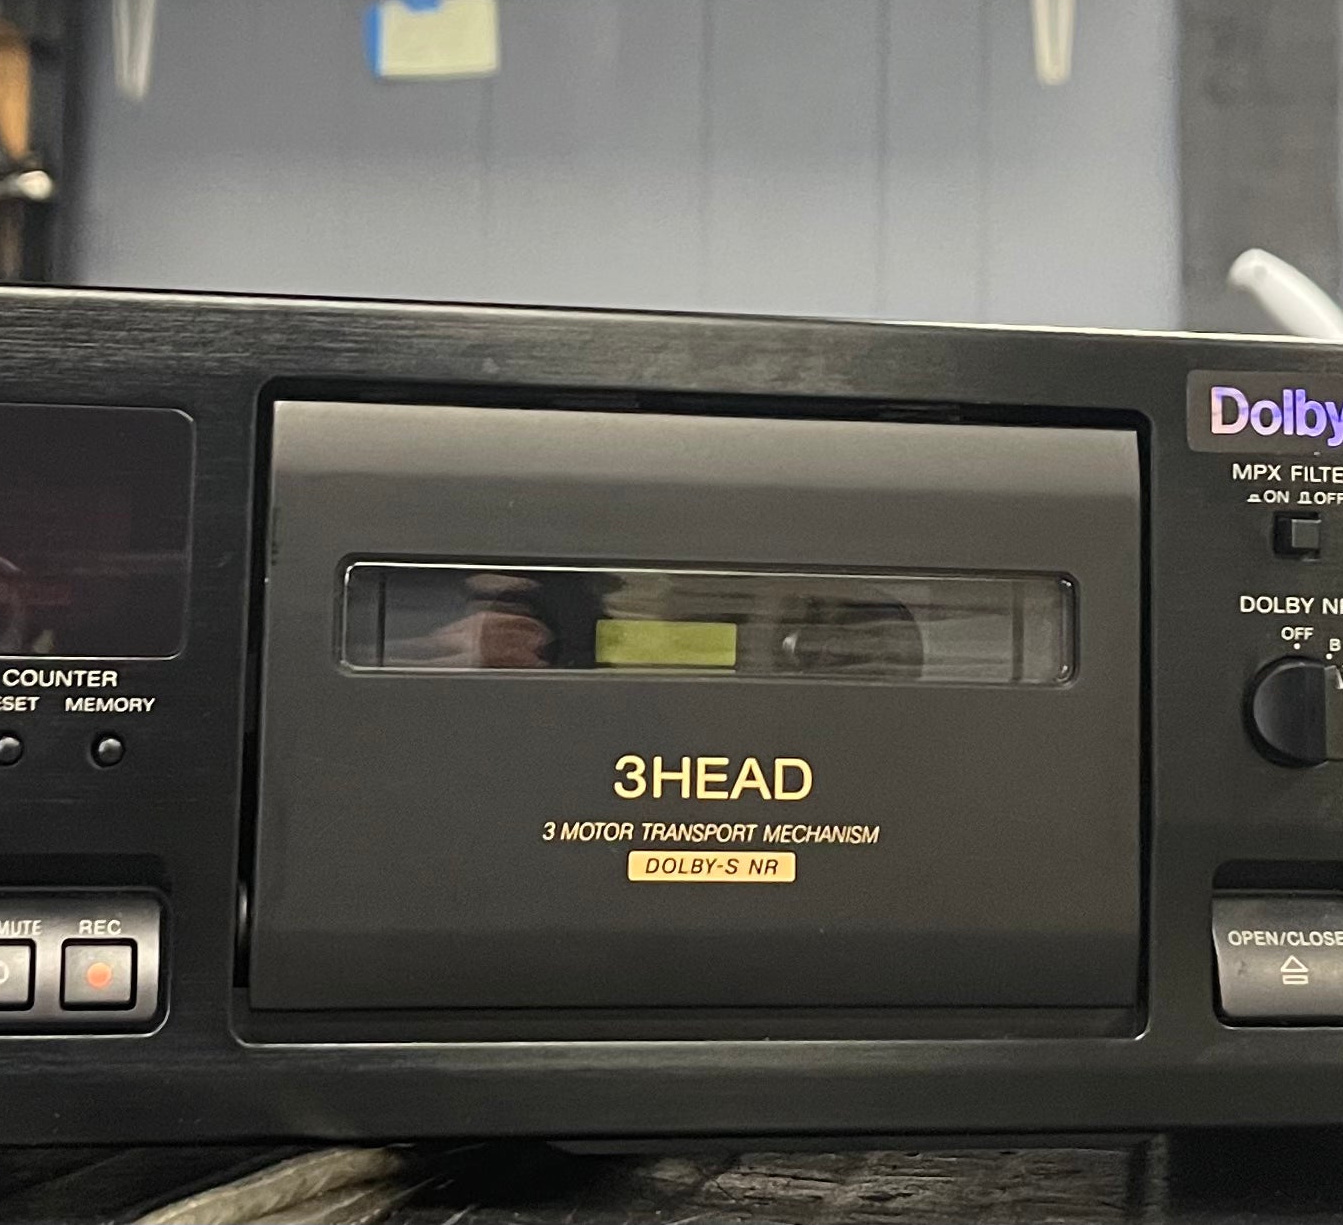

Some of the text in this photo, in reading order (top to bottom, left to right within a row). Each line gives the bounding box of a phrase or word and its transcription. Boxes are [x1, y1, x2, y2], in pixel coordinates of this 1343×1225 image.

[1232, 463, 1282, 482] MPX
[1263, 489, 1290, 504] ON
[1240, 595, 1315, 614] DOLBY
[1280, 626, 1314, 641] OFF
[1329, 638, 1342, 652] B
[2, 668, 118, 688] COUNTER
[65, 697, 156, 713] MEMORY
[614, 755, 813, 800] 3HEAD
[542, 821, 880, 844] 3 MOTOR TRANSPORT MECHANISM
[644, 856, 779, 877] DOLBY-S NR
[78, 918, 122, 937] REC
